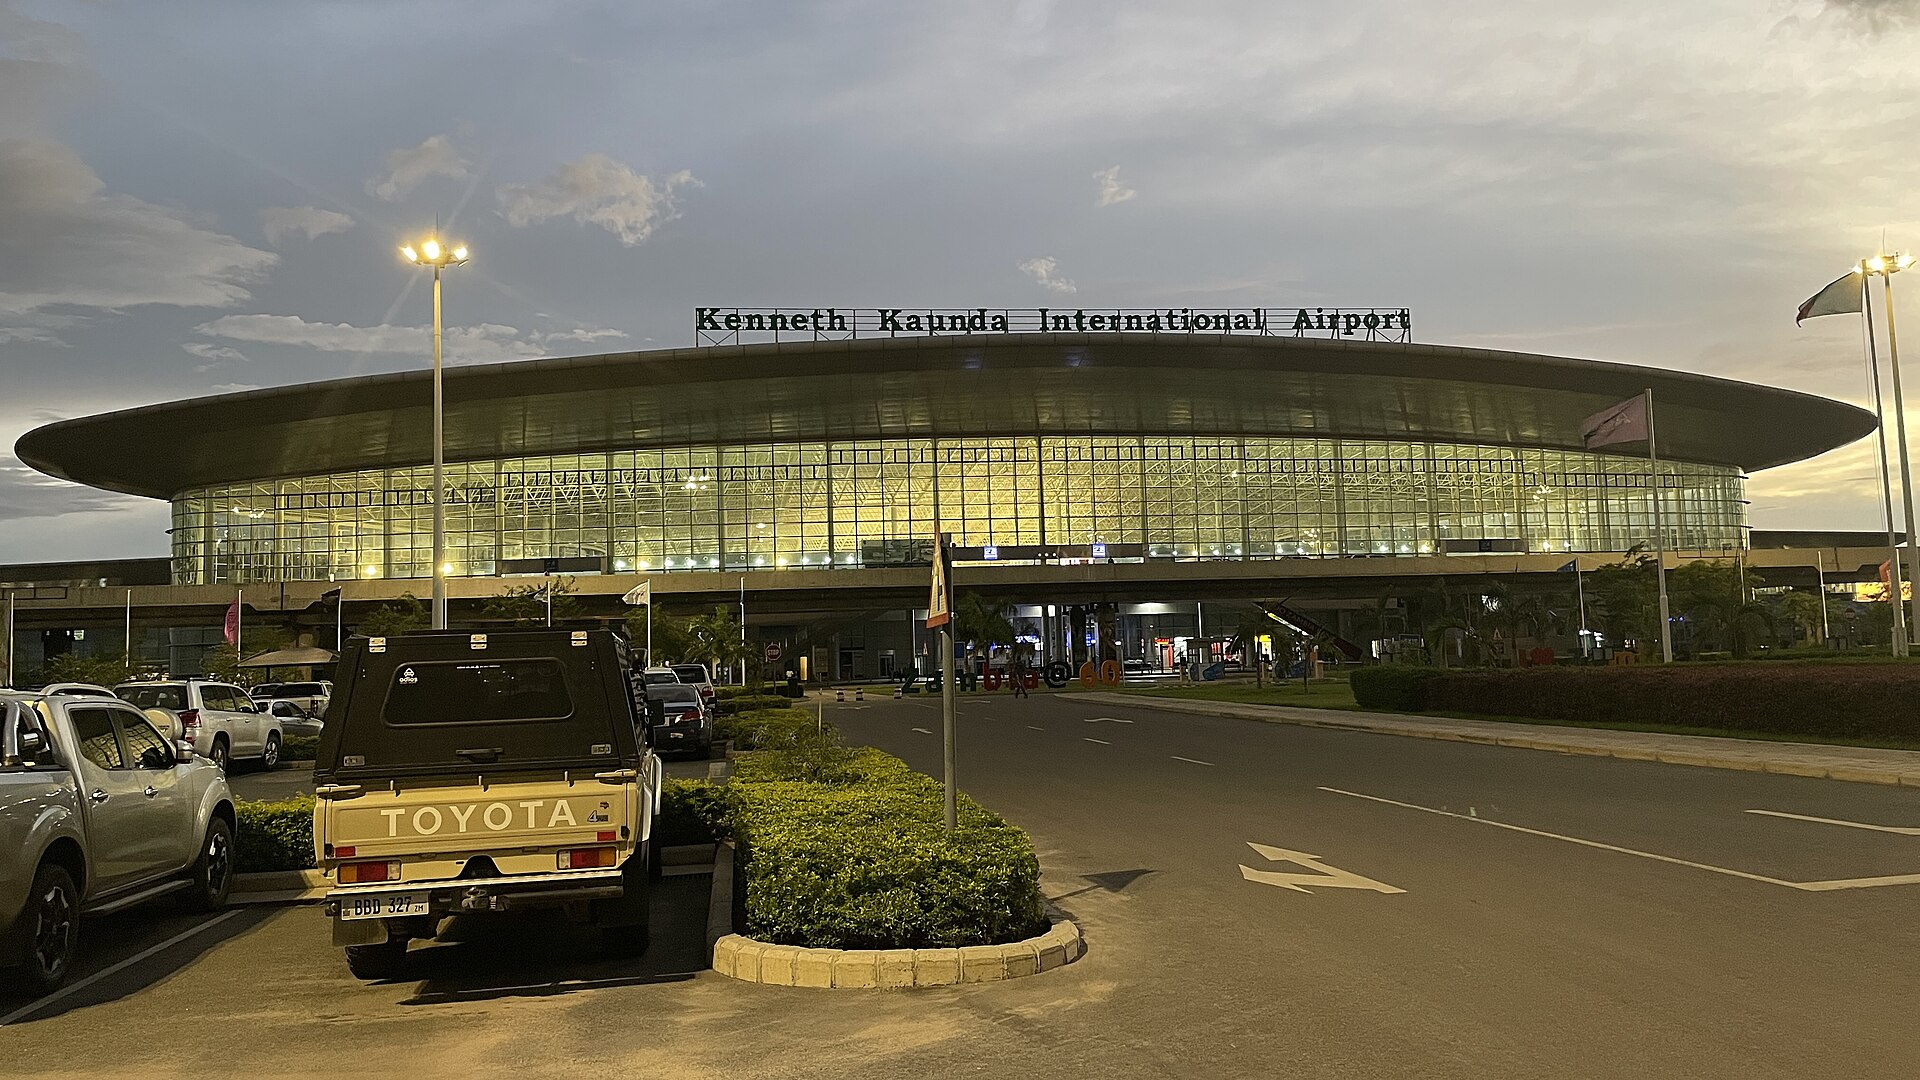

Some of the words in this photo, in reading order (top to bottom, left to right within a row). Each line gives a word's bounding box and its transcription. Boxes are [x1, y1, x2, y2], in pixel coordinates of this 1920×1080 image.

[696, 308, 847, 331] Kenneth
[878, 308, 1008, 331] Kaunda
[1038, 308, 1266, 331] International
[1292, 307, 1411, 335] Airport
[380, 799, 577, 837] TOYOTA
[354, 898, 381, 915] BBD
[388, 896, 412, 913] 327
